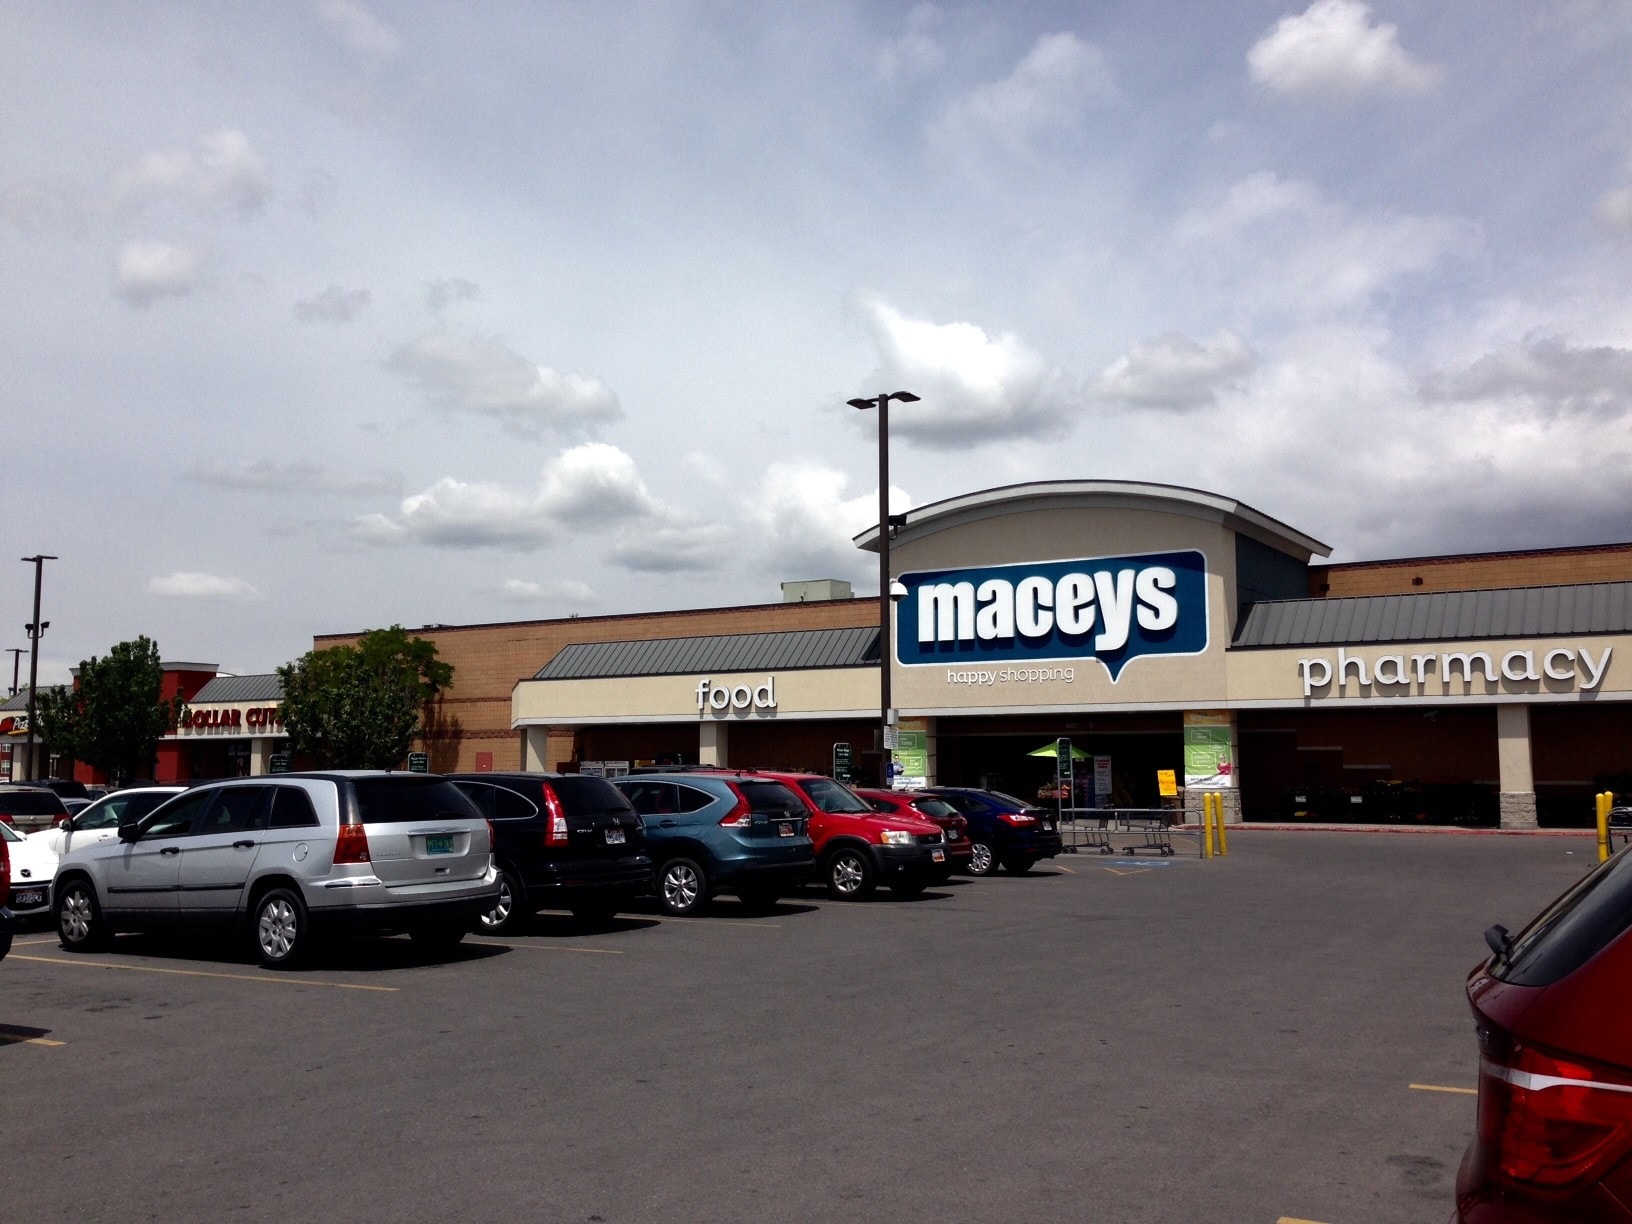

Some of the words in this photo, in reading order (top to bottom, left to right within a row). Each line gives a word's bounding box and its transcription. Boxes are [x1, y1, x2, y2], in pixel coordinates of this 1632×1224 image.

[918, 567, 1178, 651] maceys
[947, 669, 997, 686] happy
[1000, 666, 1074, 684] shopping
[1298, 648, 1613, 696] pharmacy
[695, 676, 777, 709] food
[182, 709, 241, 728] DOLLAR
